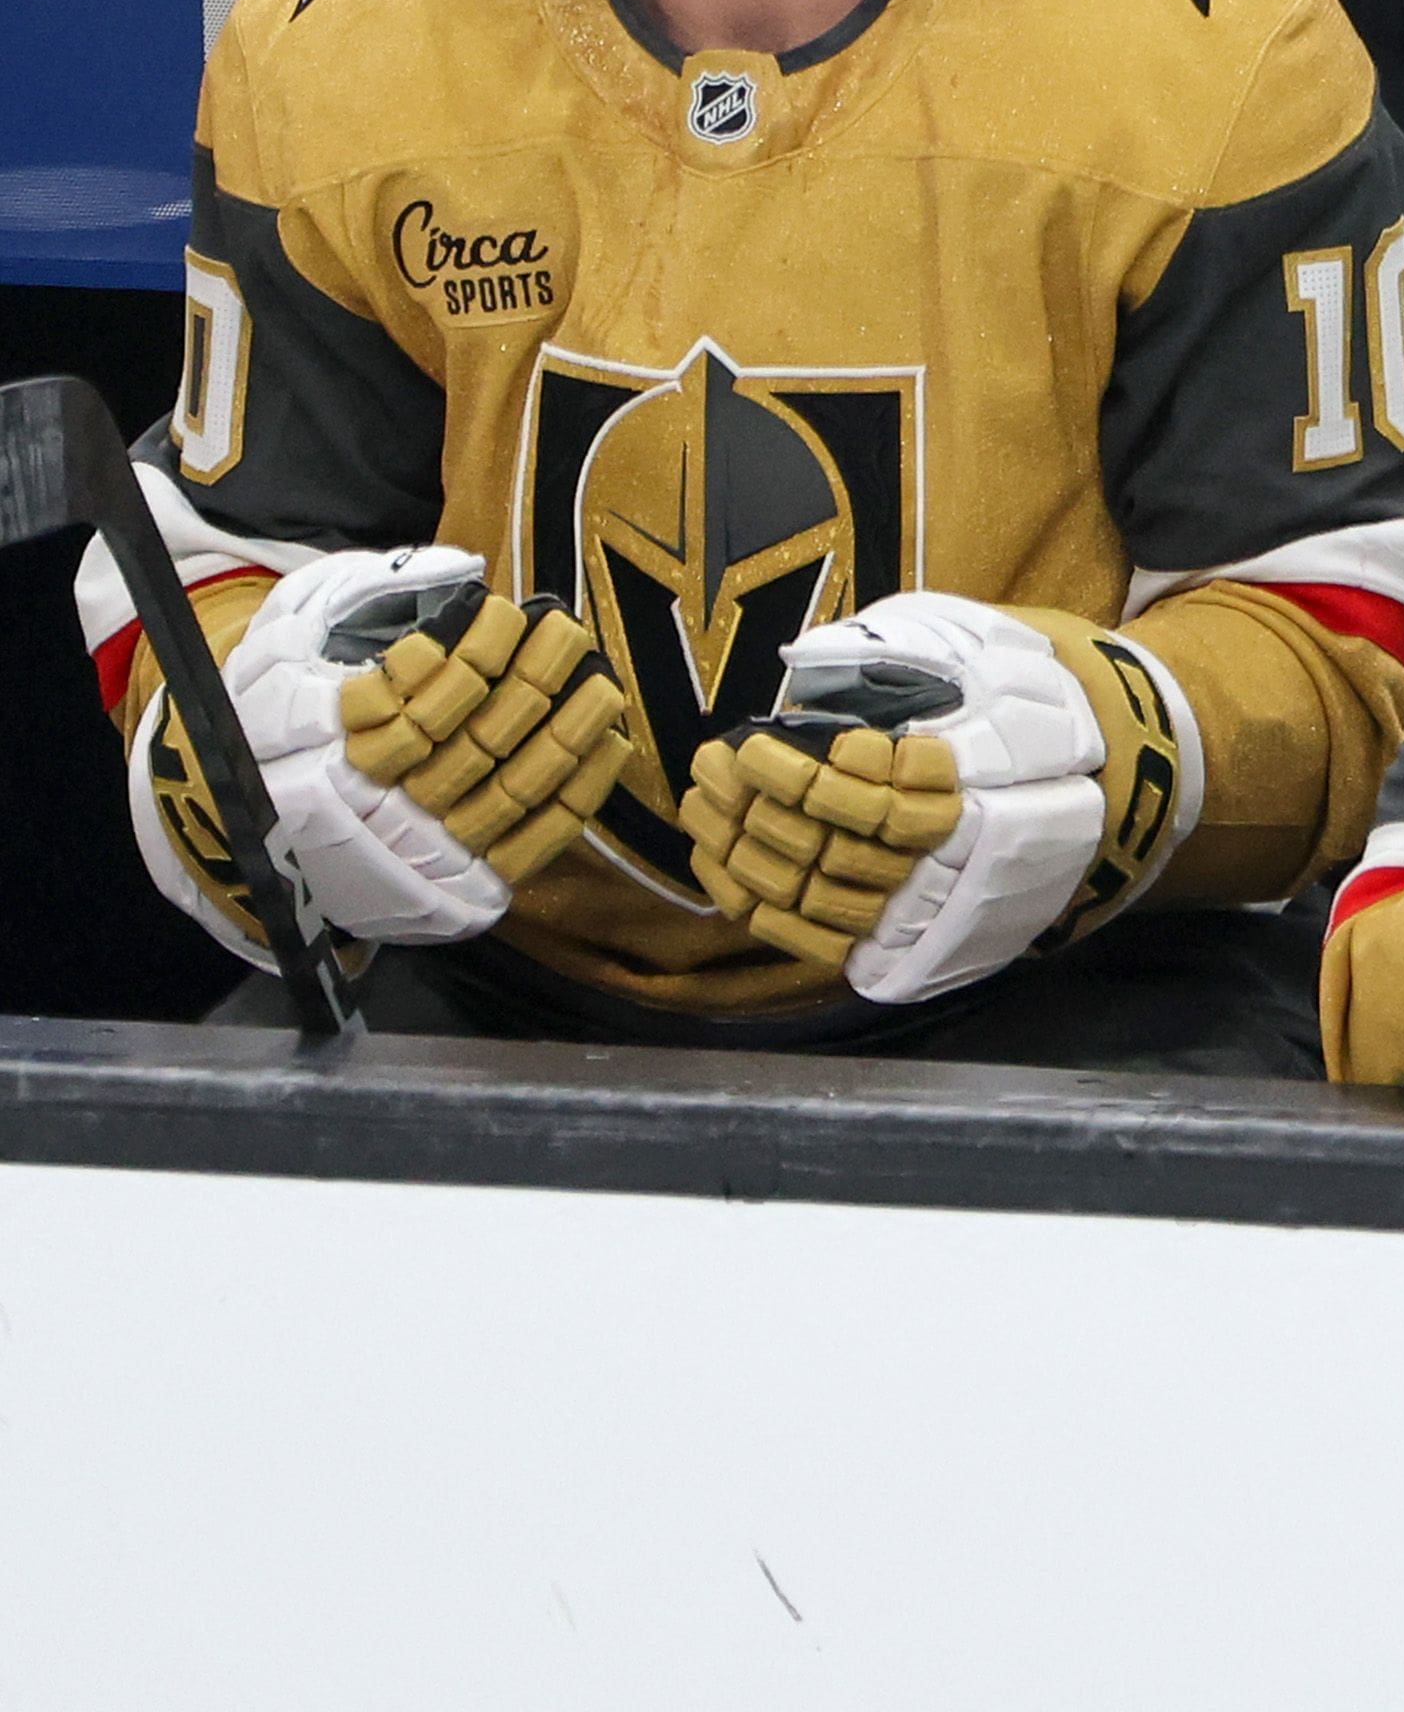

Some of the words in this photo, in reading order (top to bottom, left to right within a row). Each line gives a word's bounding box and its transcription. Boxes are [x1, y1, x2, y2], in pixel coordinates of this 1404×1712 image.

[703, 91, 742, 128] NHL
[392, 200, 549, 288] Circa
[443, 270, 553, 315] SPORTS
